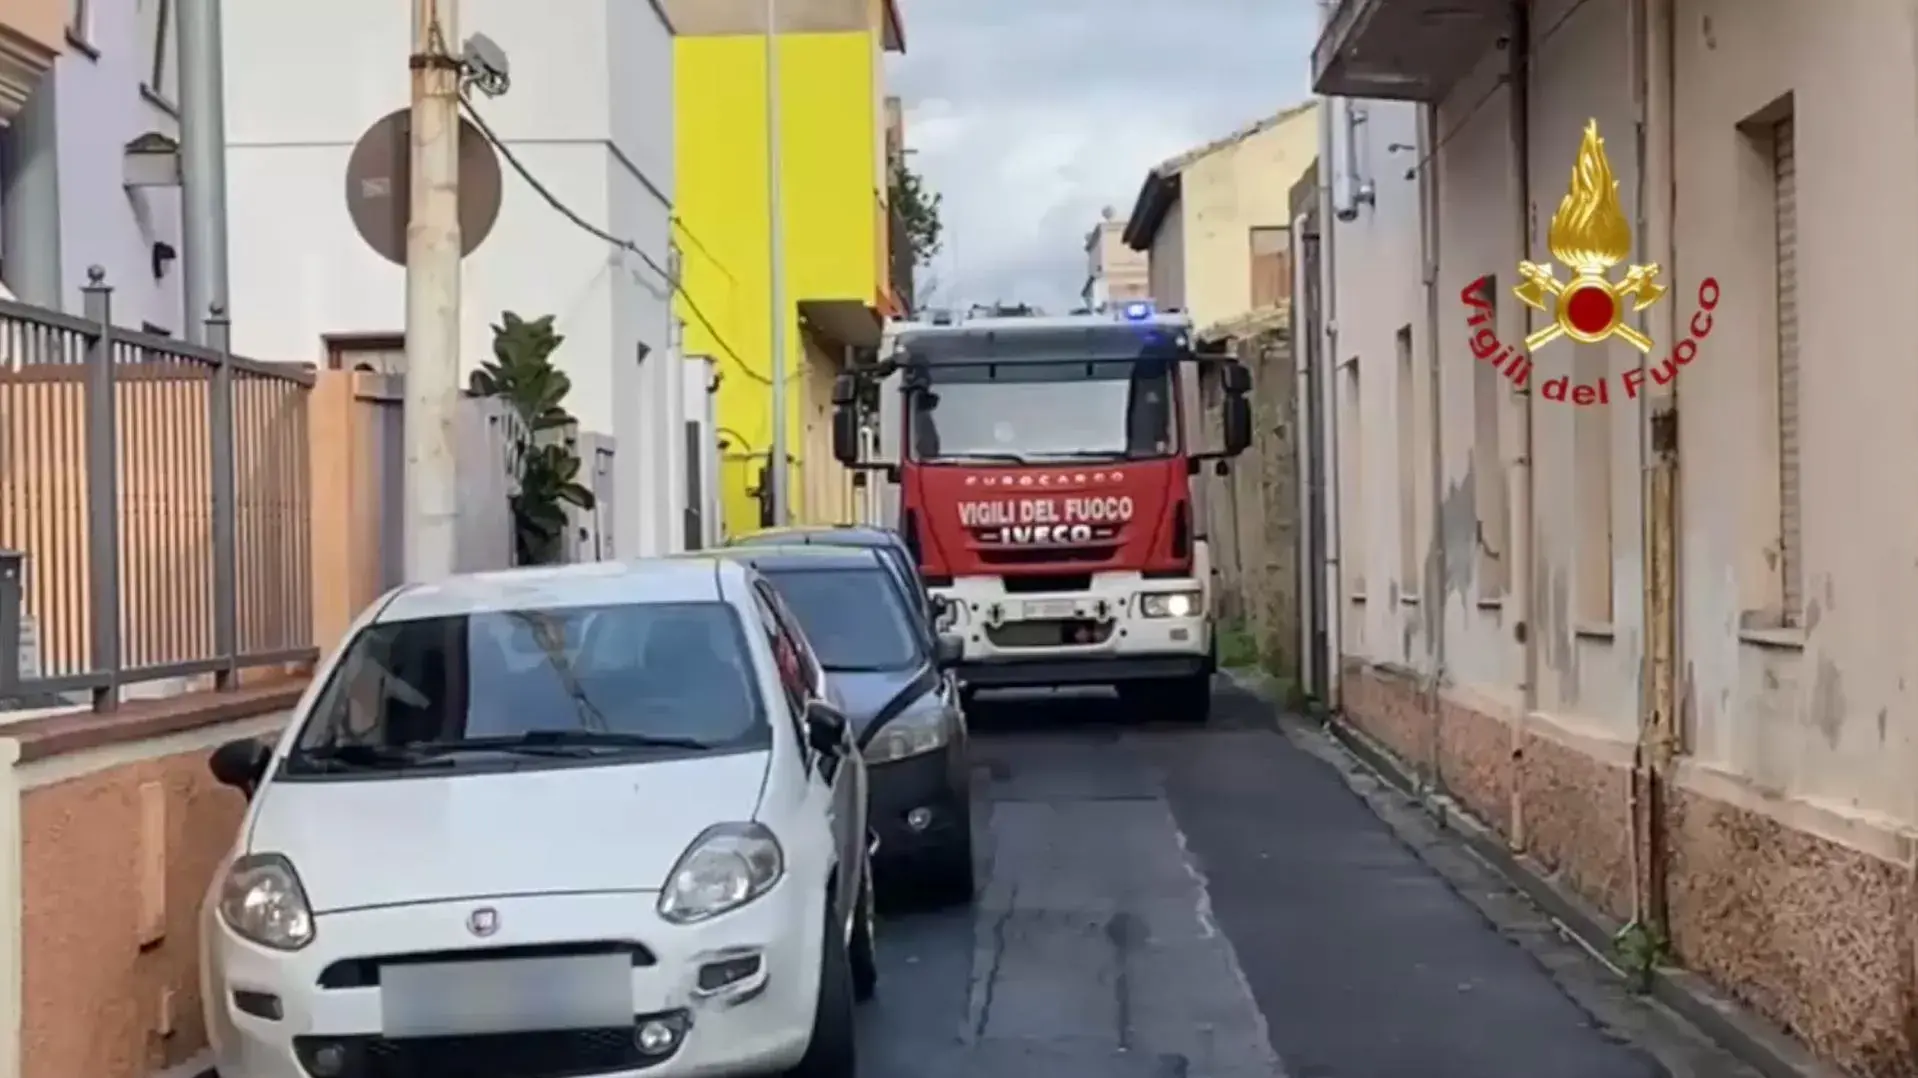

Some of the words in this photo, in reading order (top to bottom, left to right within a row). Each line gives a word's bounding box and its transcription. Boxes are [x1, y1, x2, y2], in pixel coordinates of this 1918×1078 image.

[958, 501, 1015, 525] VIGILI
[1020, 499, 1059, 523] DEL
[1065, 496, 1133, 521] FUOCO
[1001, 524, 1091, 544] IVECO
